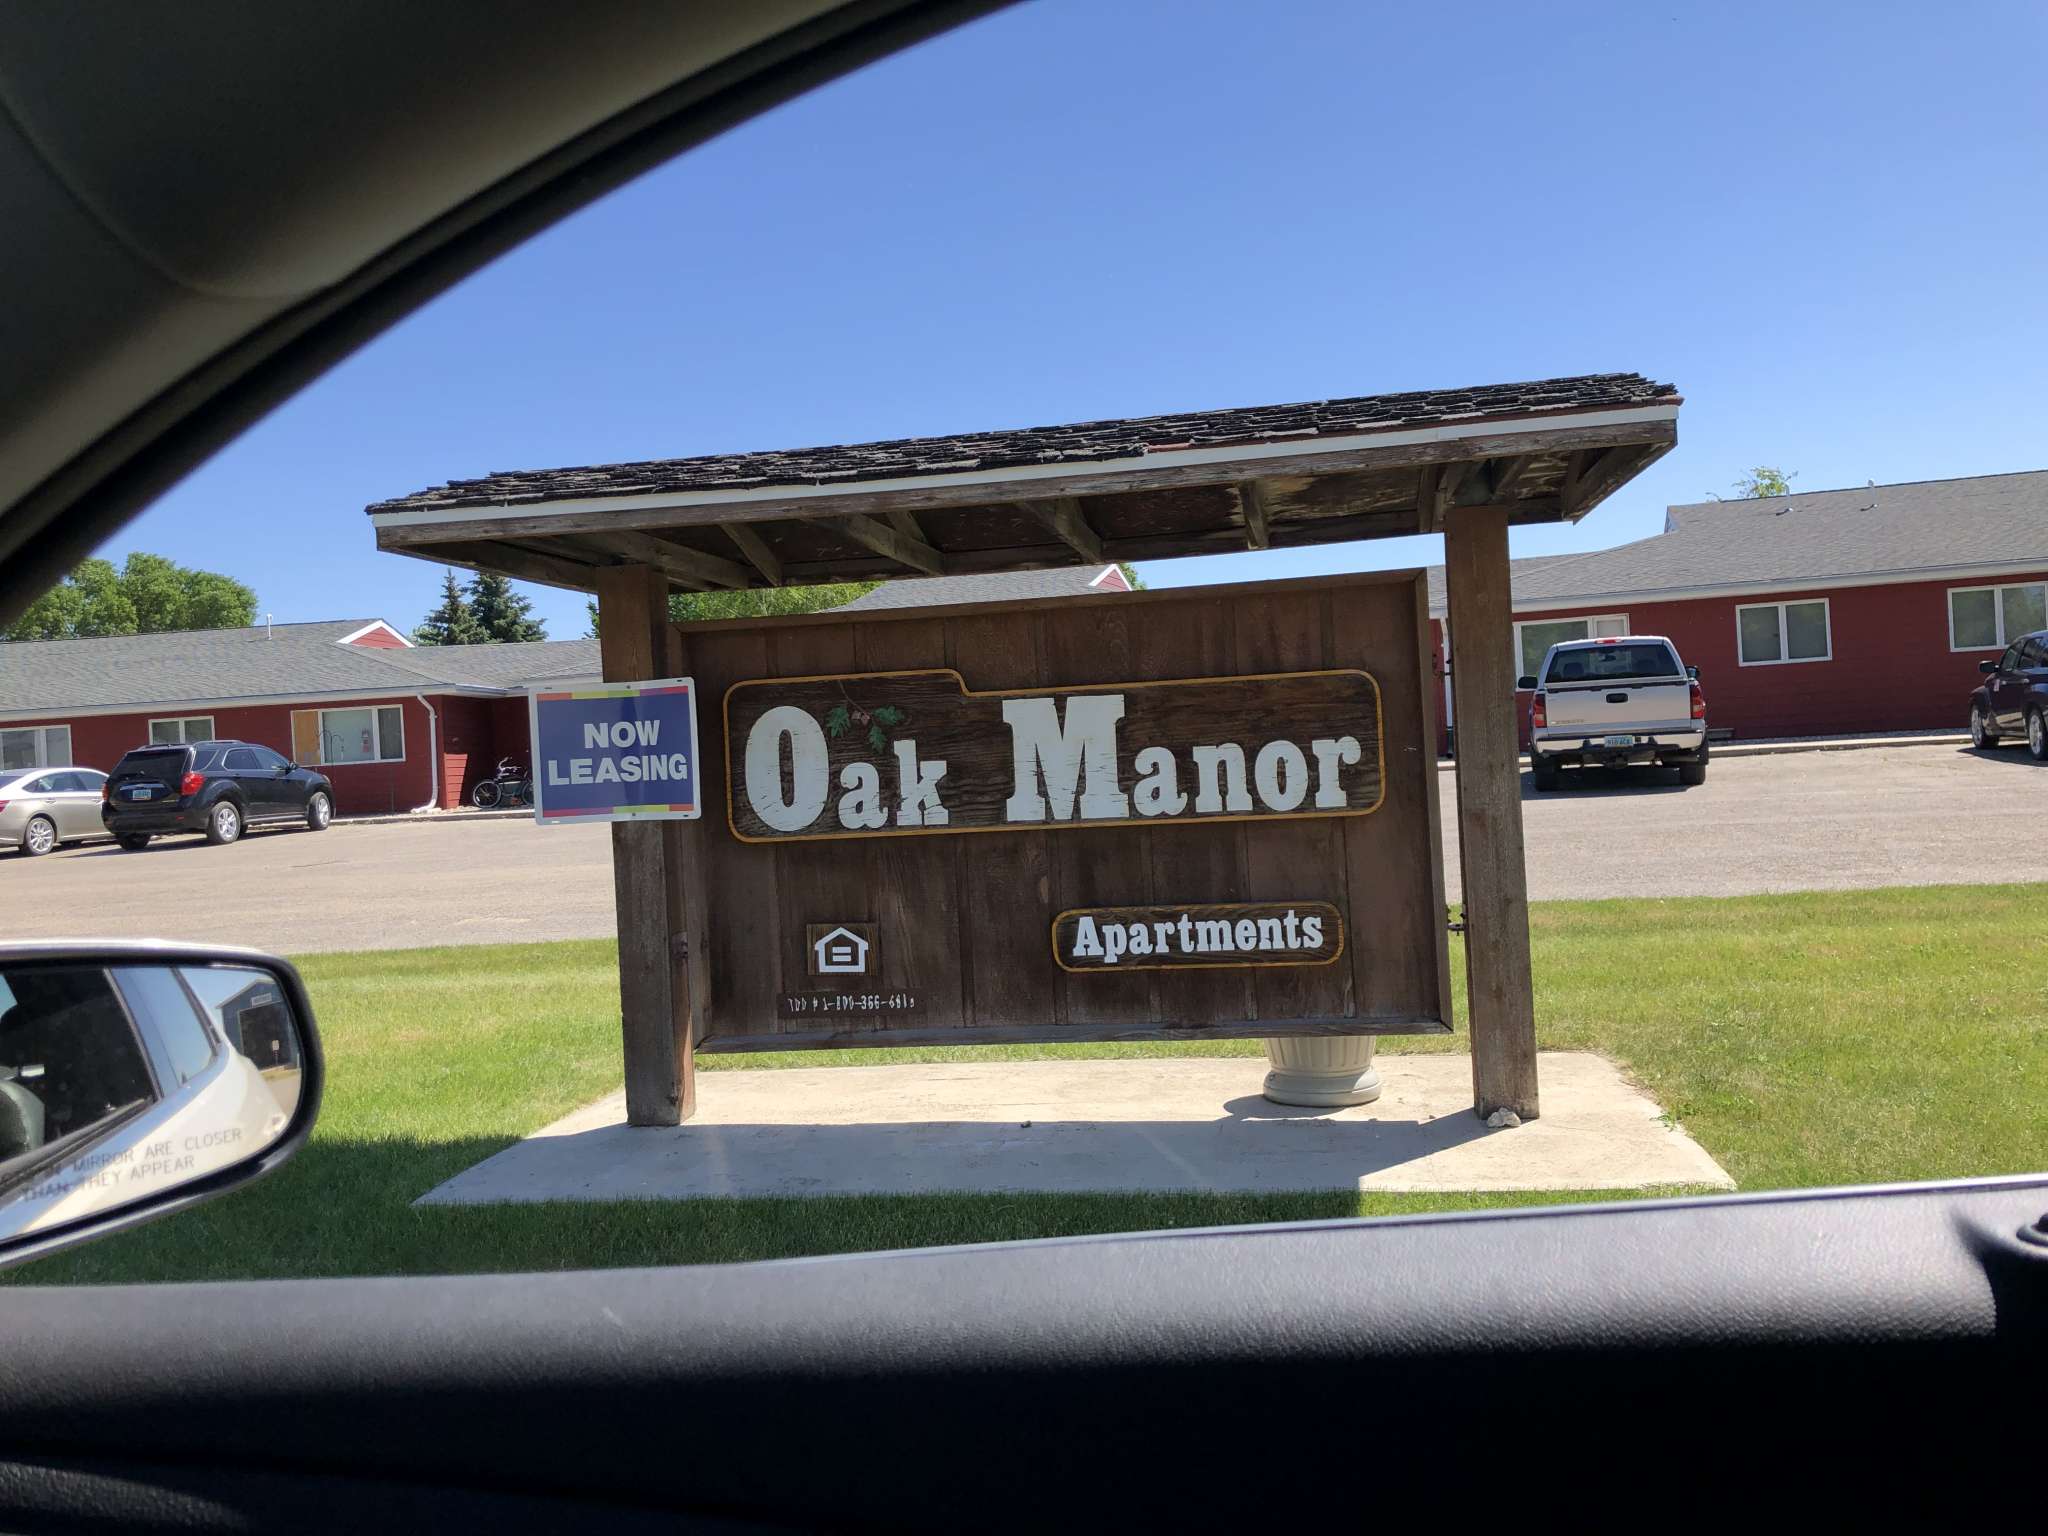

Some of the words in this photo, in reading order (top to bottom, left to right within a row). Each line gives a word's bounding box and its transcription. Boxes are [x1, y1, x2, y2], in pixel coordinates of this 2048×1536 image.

[584, 720, 660, 749] NOW
[548, 753, 688, 786] LEASING
[745, 705, 948, 831] Oak
[1002, 694, 1362, 821] Manor
[1072, 909, 1324, 963] Apartments
[72, 1149, 135, 1172] MIRROR
[144, 1140, 174, 1160] ARE
[184, 1127, 243, 1151] CLOSER
[130, 1155, 196, 1181] APPEAR
